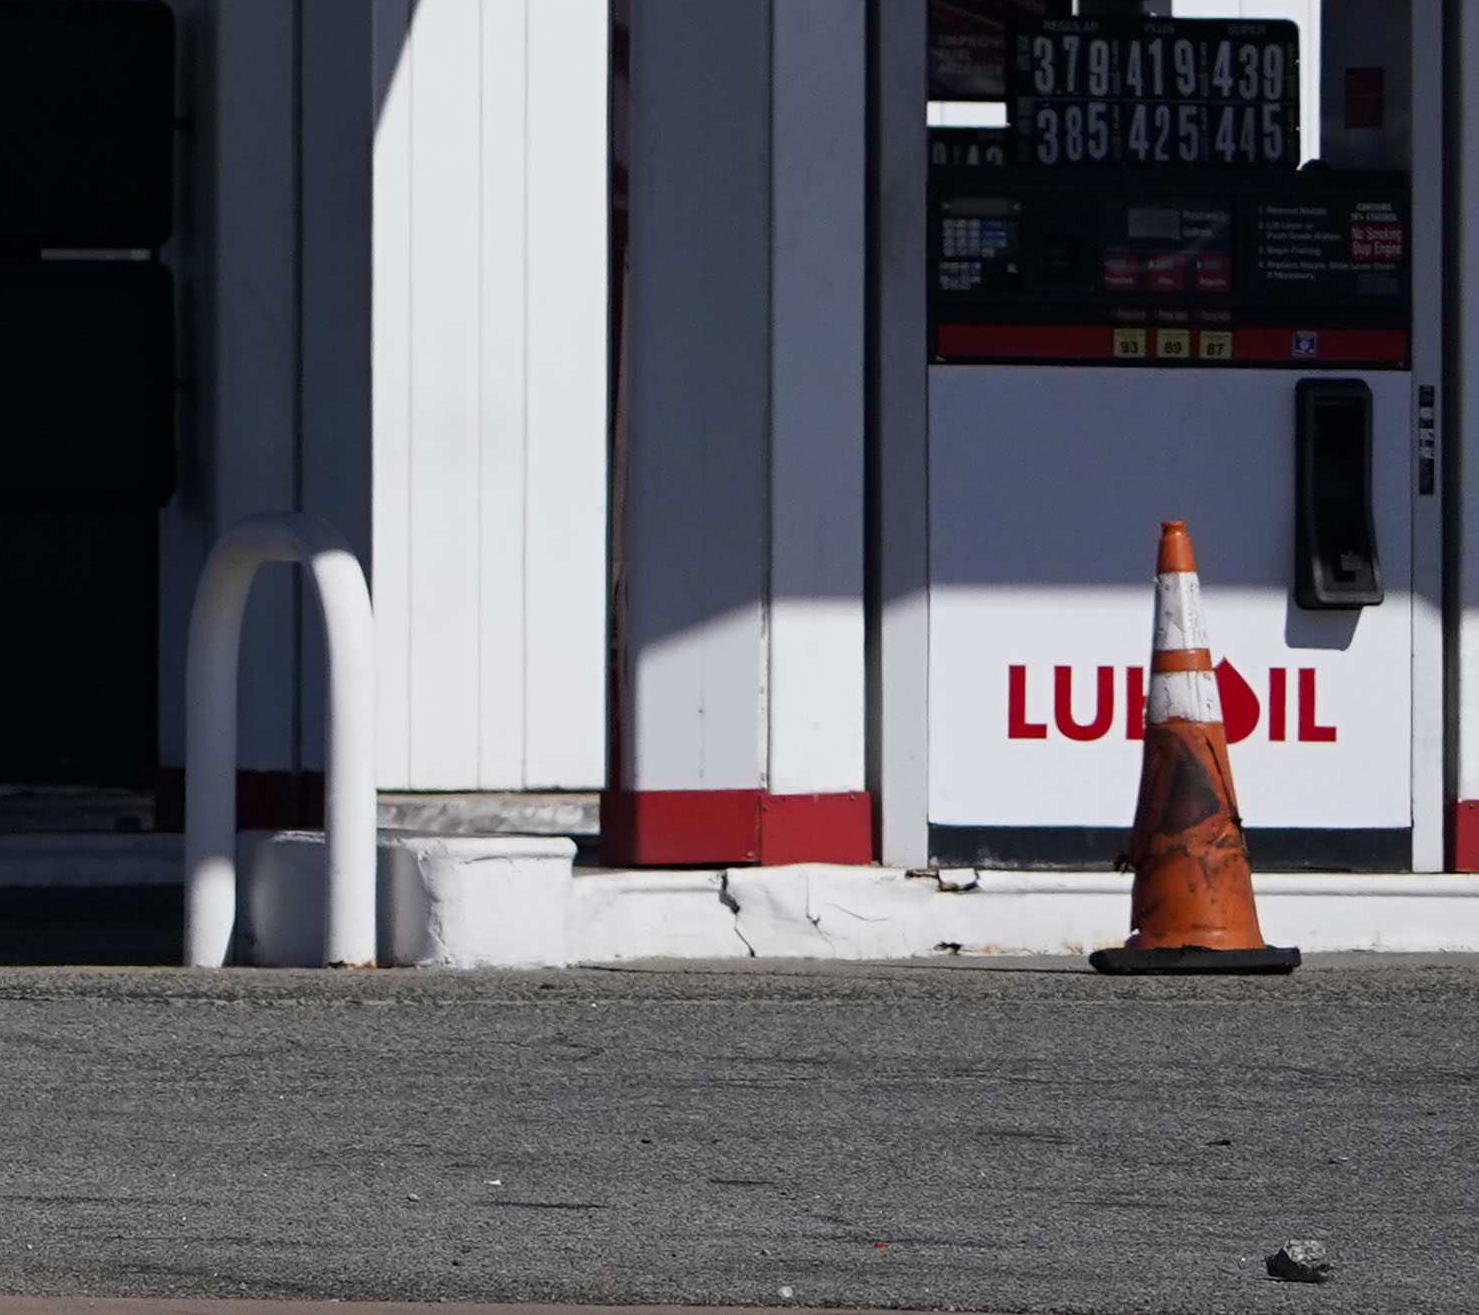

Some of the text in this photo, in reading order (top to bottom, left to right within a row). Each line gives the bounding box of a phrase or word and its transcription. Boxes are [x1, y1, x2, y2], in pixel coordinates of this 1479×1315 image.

[1126, 37, 1198, 99] 419
[1212, 39, 1284, 102] 439
[1036, 100, 1110, 166] 385
[1127, 101, 1200, 164] 425
[1214, 101, 1284, 164] 445
[1120, 340, 1139, 355] 93
[1163, 340, 1183, 355] 89
[1206, 342, 1225, 356] 87
